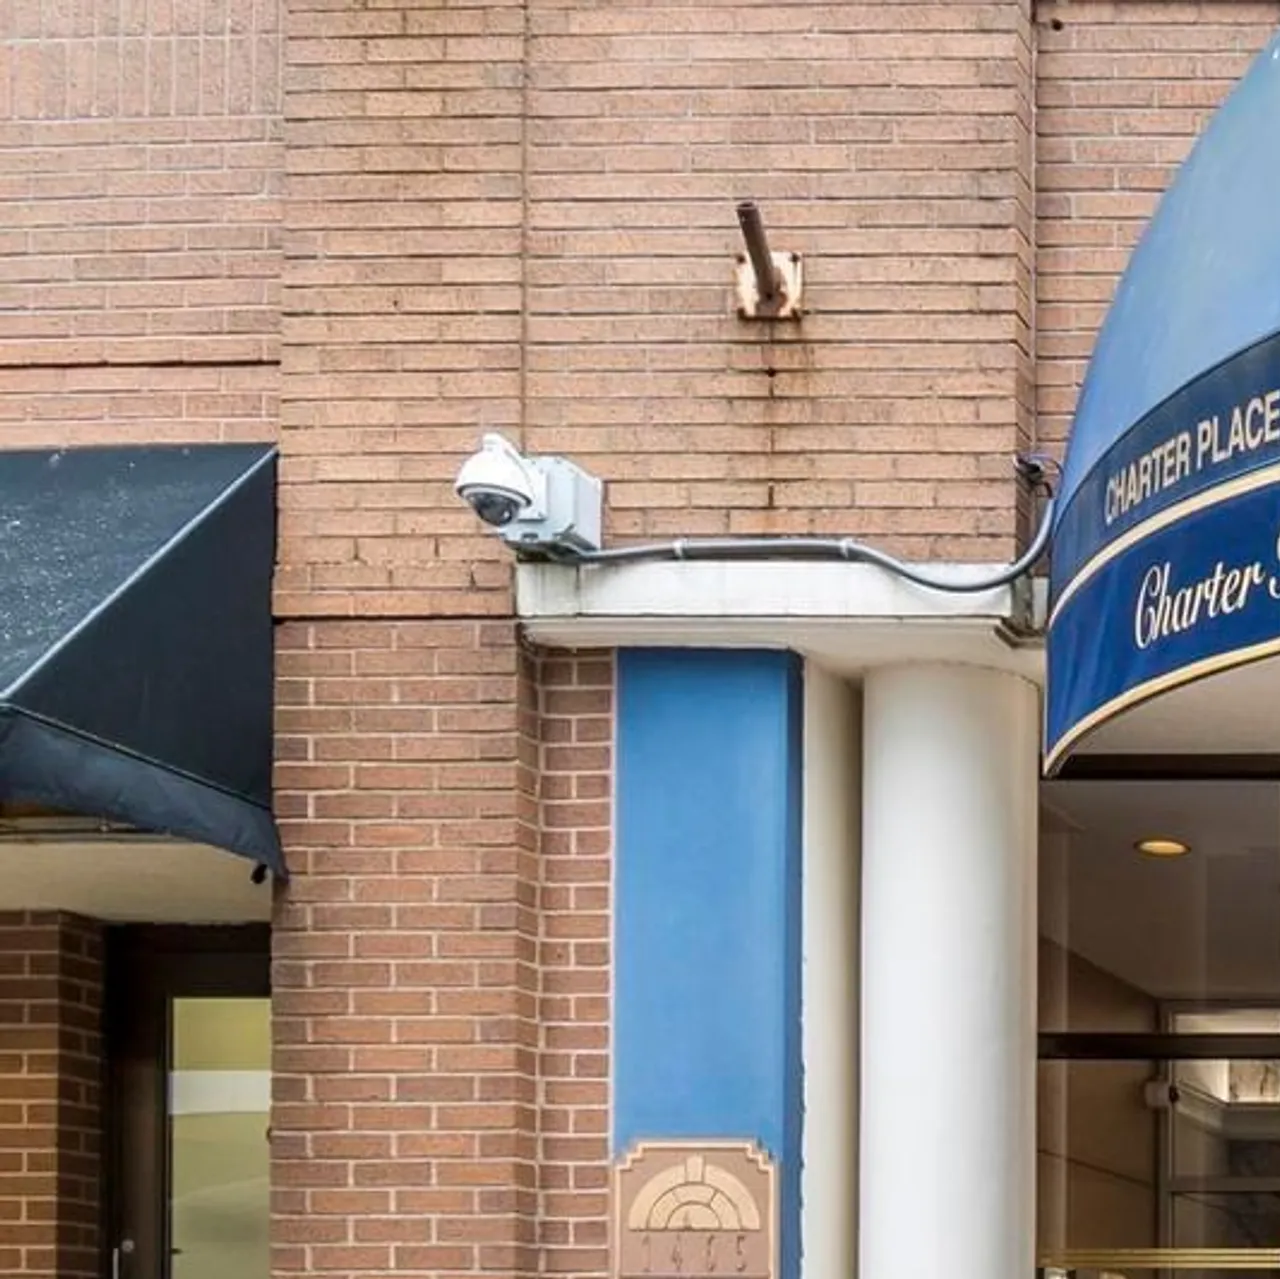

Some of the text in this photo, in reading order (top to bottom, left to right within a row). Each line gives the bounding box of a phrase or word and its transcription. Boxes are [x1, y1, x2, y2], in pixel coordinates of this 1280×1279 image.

[1104, 429, 1190, 526] CHARTER
[1197, 389, 1280, 470] PLACE
[1134, 561, 1266, 649] Charter
